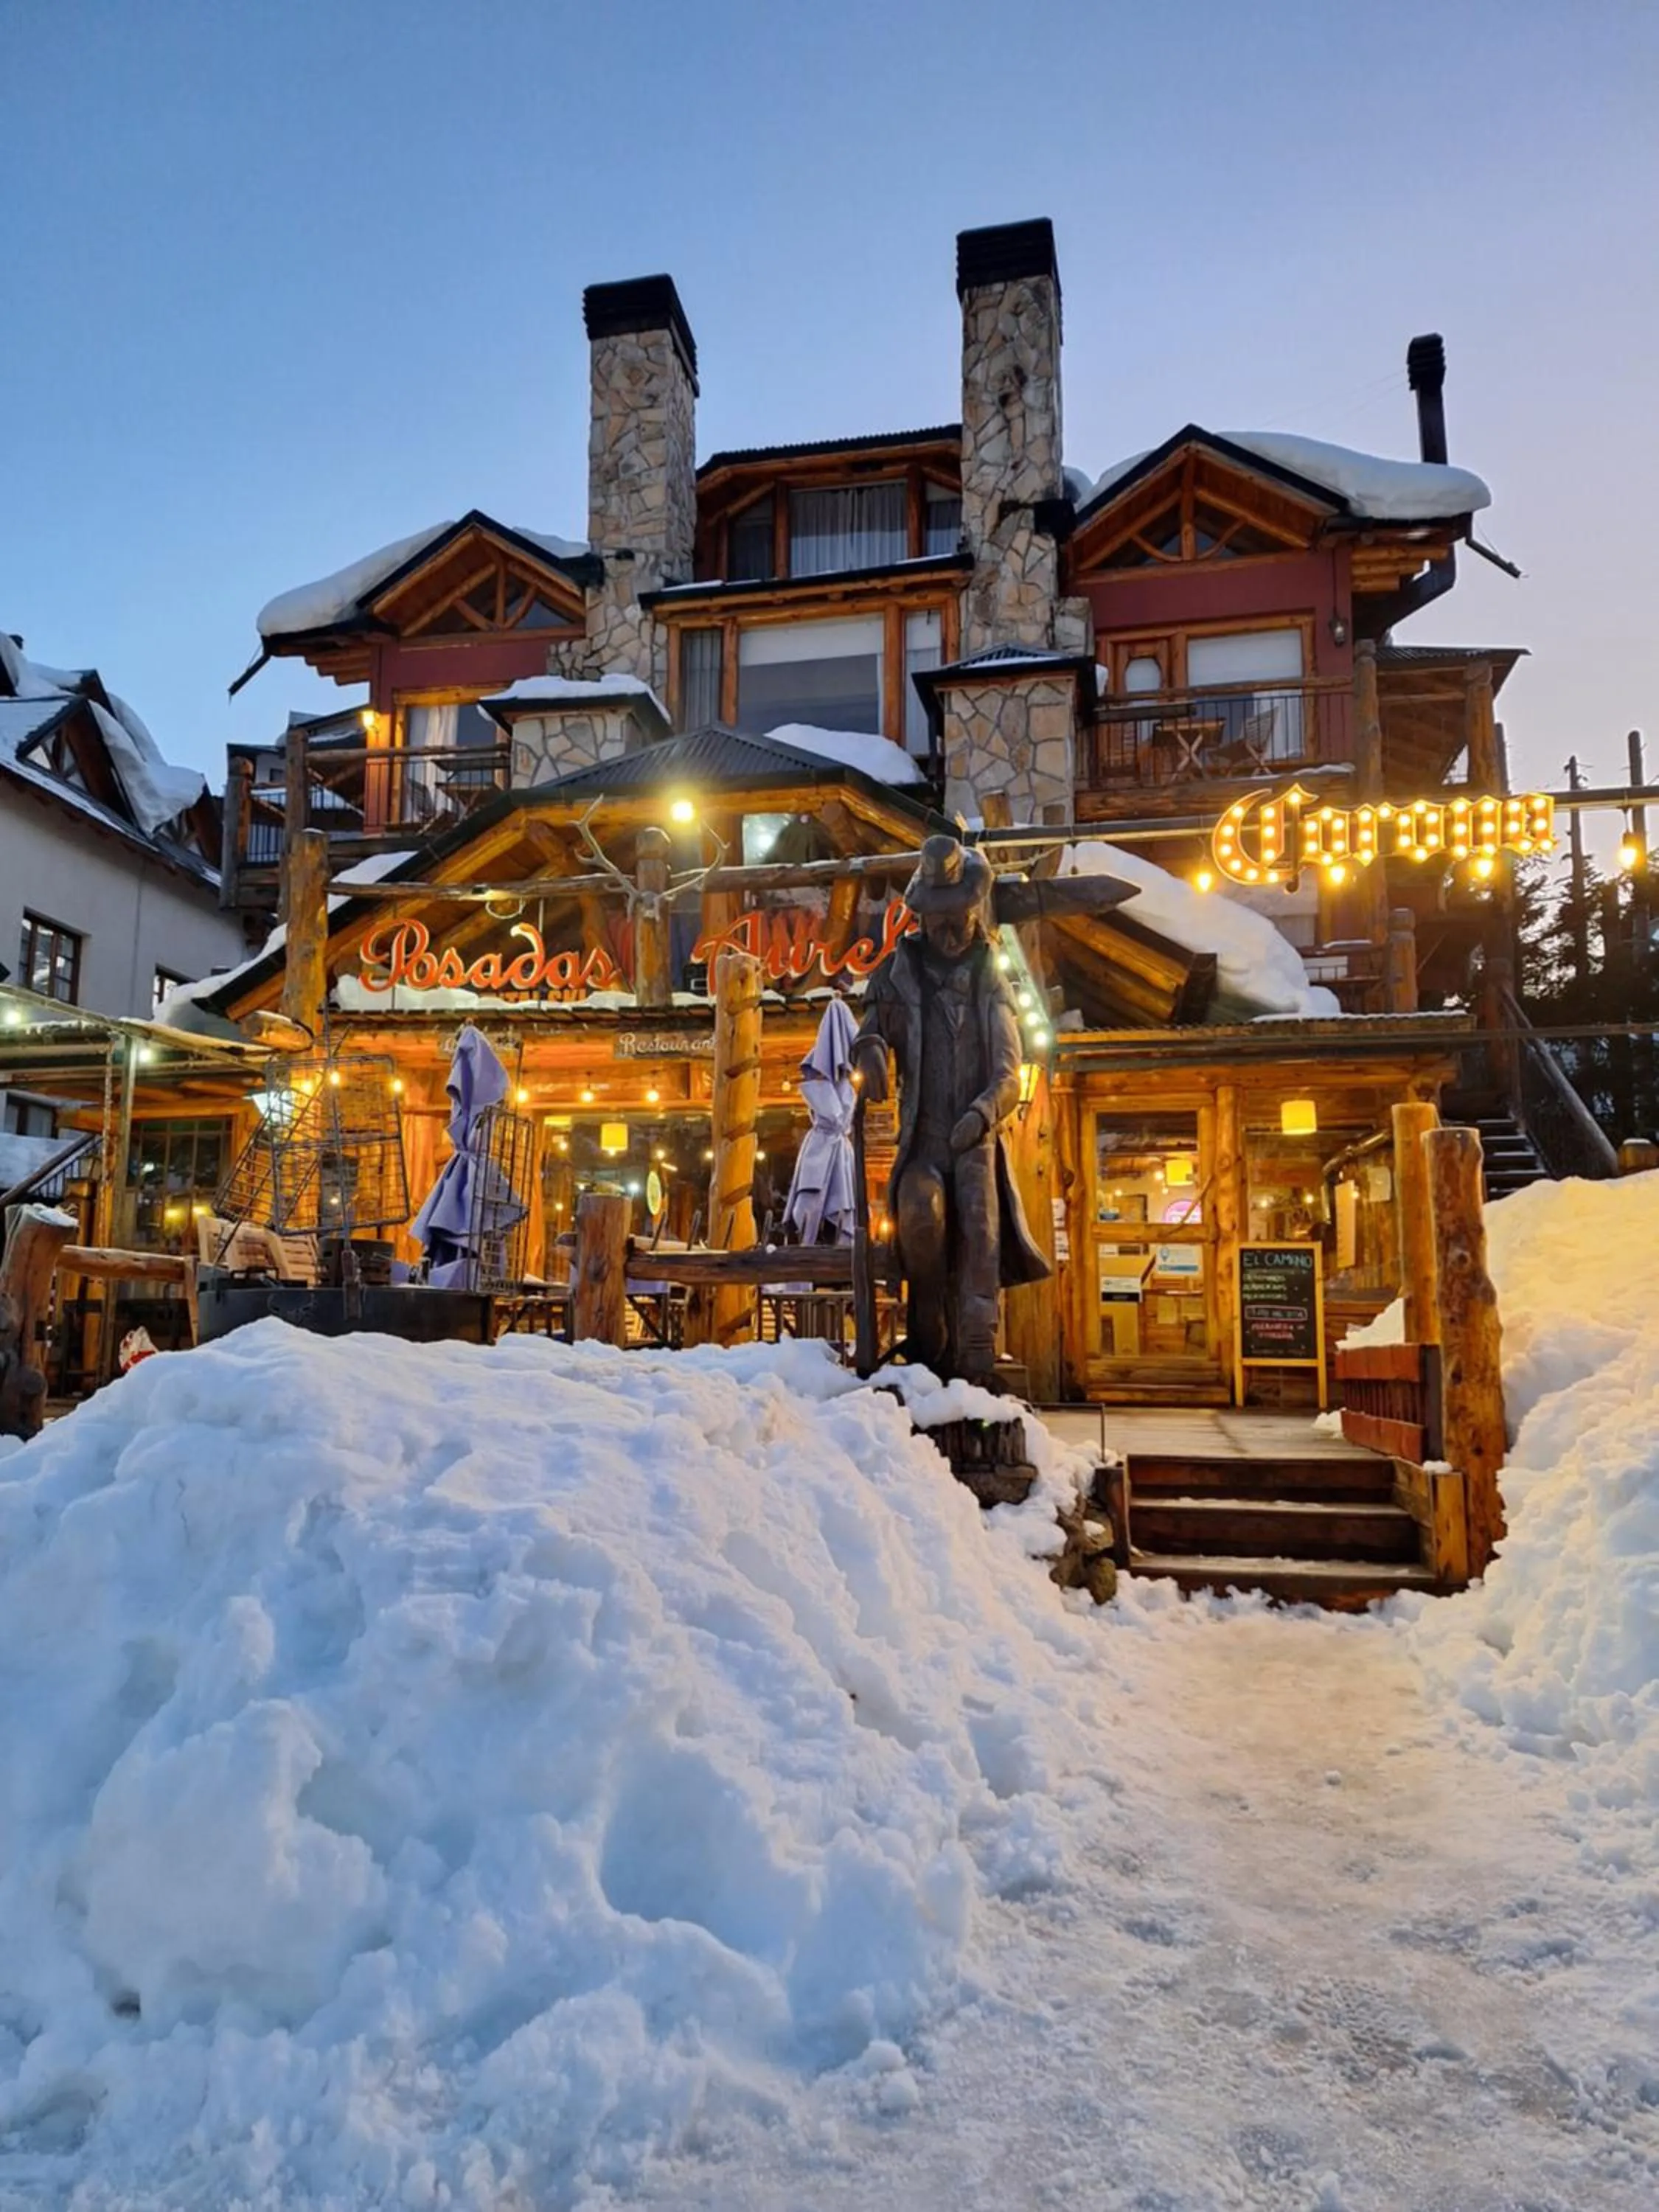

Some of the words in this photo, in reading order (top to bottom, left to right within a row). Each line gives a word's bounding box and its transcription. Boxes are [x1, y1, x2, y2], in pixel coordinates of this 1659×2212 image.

[1212, 783, 1557, 886] Corona
[358, 919, 622, 992] Posadas
[690, 895, 921, 998] Aurel
